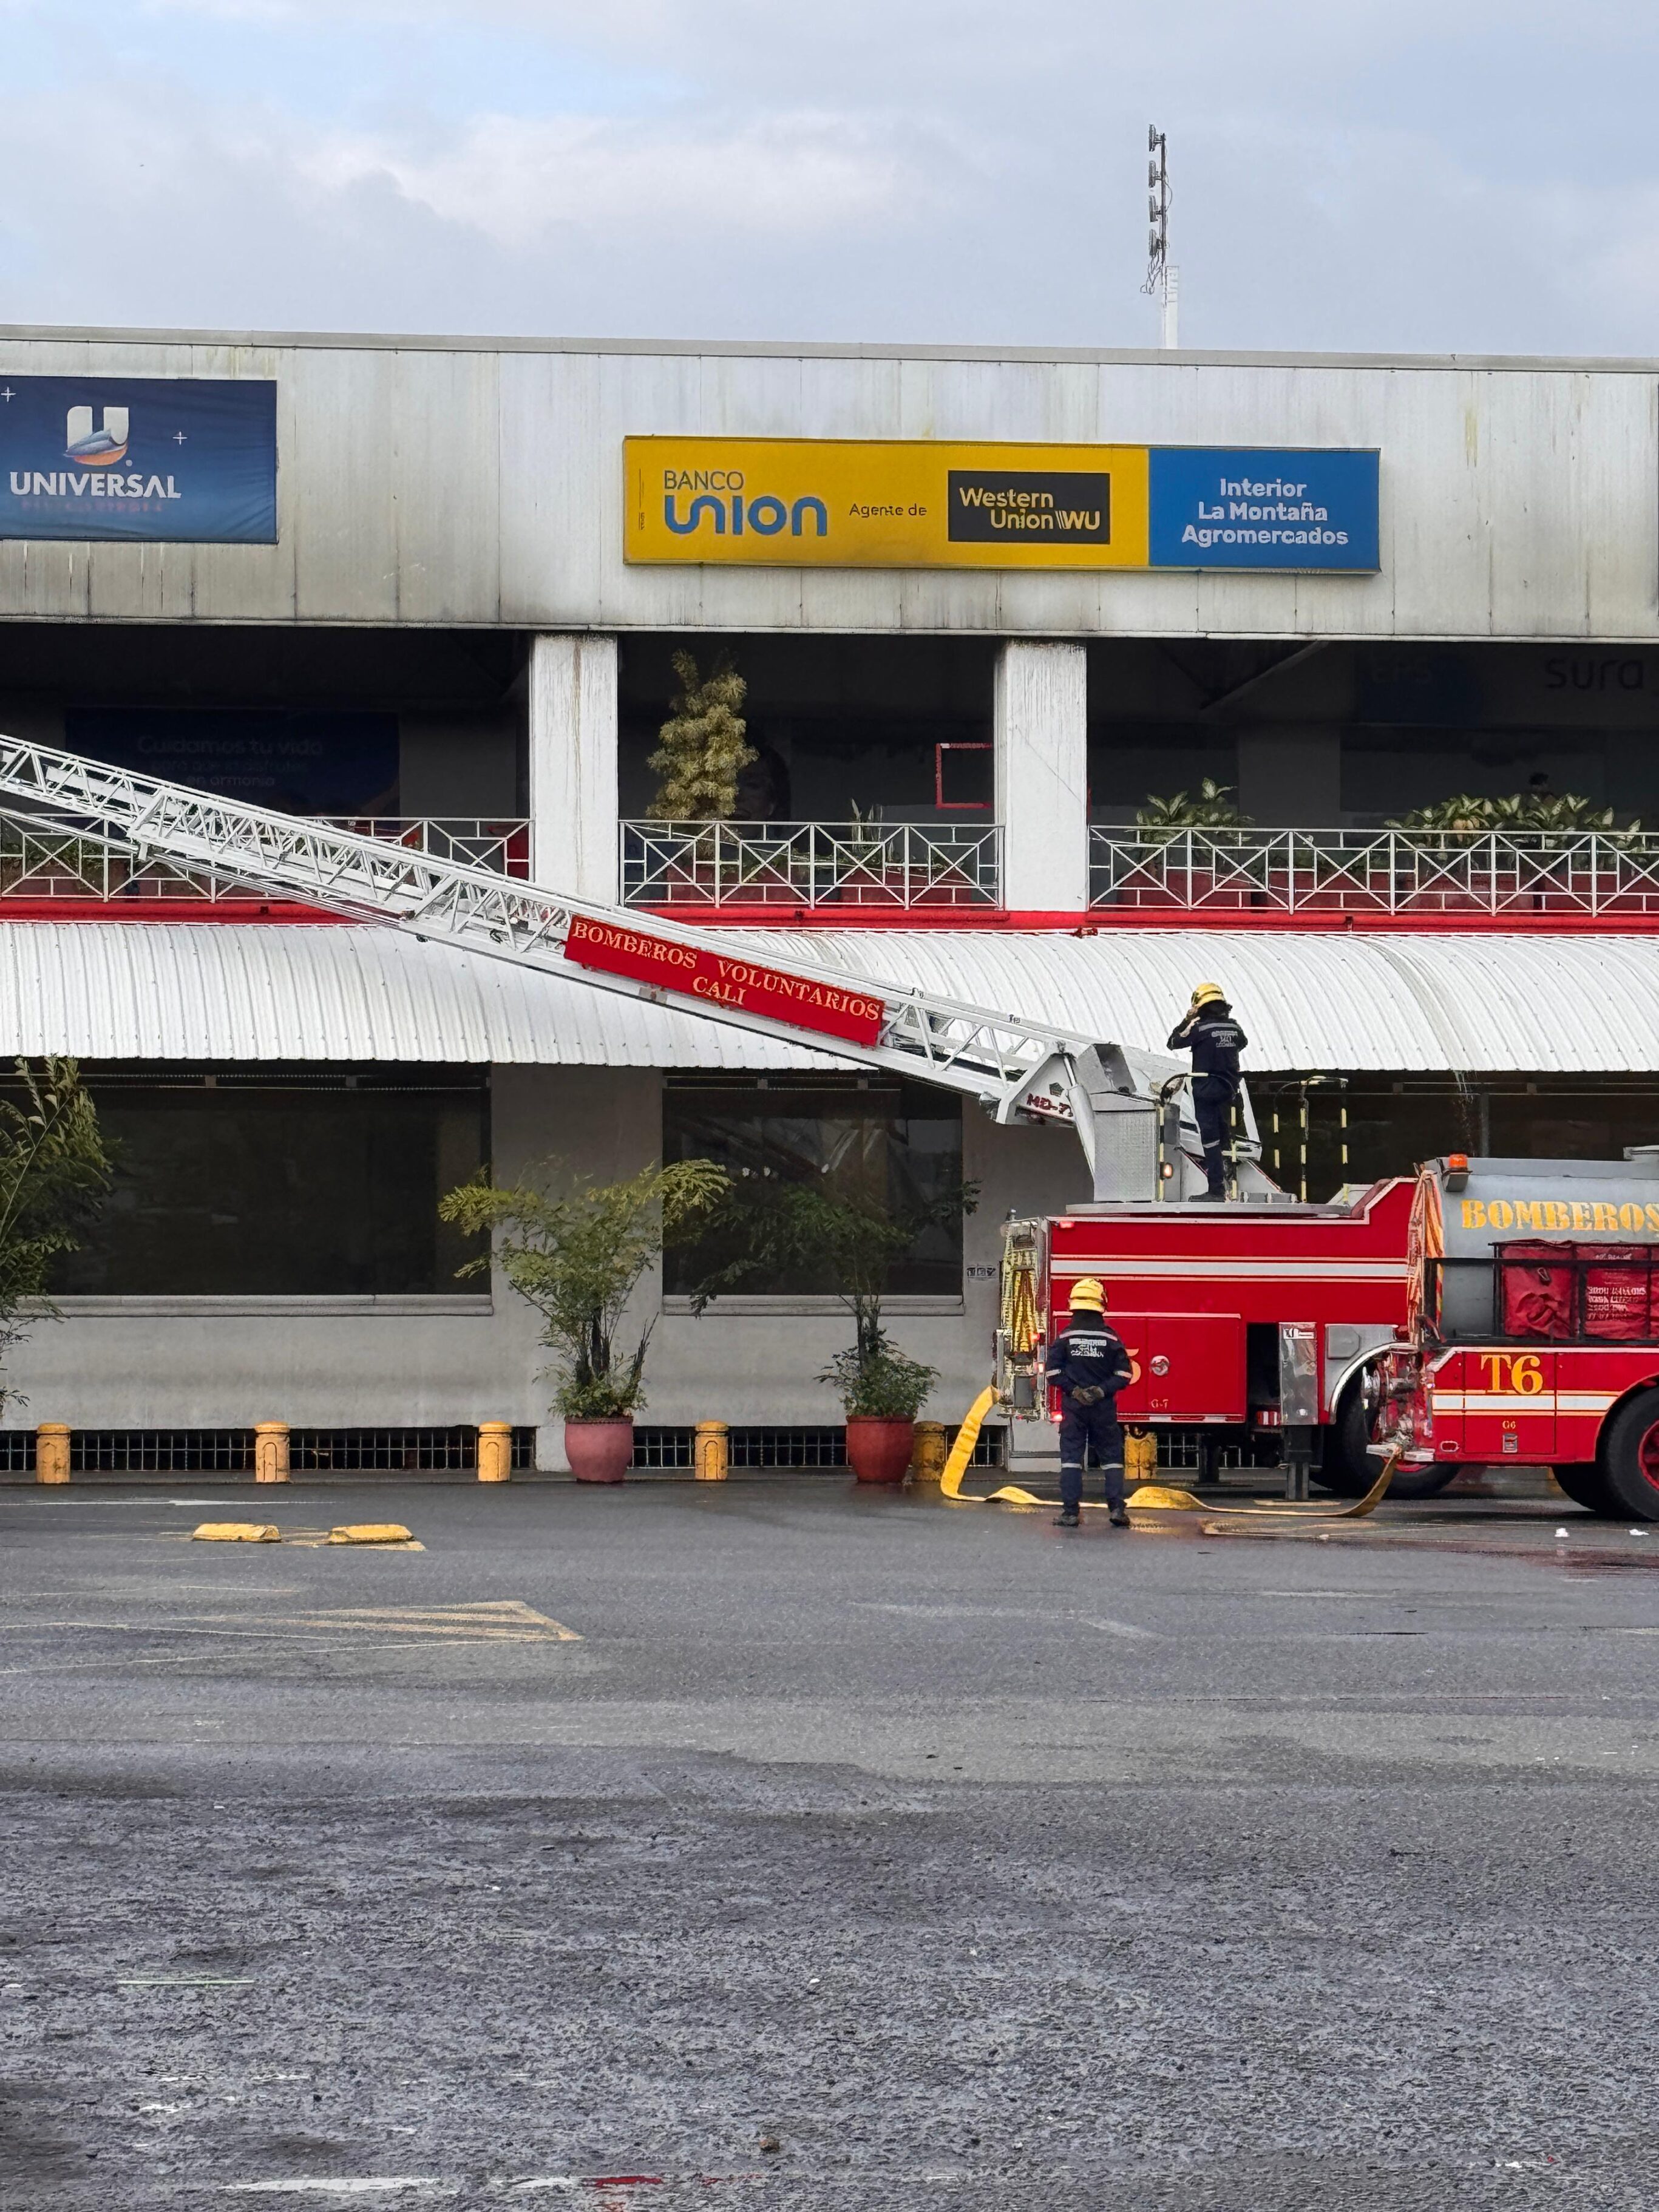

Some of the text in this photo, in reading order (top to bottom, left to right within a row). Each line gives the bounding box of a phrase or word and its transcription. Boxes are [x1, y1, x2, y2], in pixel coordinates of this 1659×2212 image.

[10, 471, 182, 499] UNIVERSAL
[664, 470, 745, 490] BANCO
[1220, 478, 1307, 497] Interior
[959, 487, 1054, 508] Western
[849, 503, 928, 518] Agente de
[991, 508, 1054, 529] Union
[1198, 501, 1328, 521] La Montaña
[1182, 524, 1349, 548] Agromercados
[137, 735, 324, 755] Cuidamos tu vida
[574, 920, 881, 1020] BOMBEROS VOLUNTARIOS
[693, 976, 748, 1006] CALI
[1461, 1199, 1659, 1232] BOMBEROS
[1481, 1354, 1543, 1394] T6
